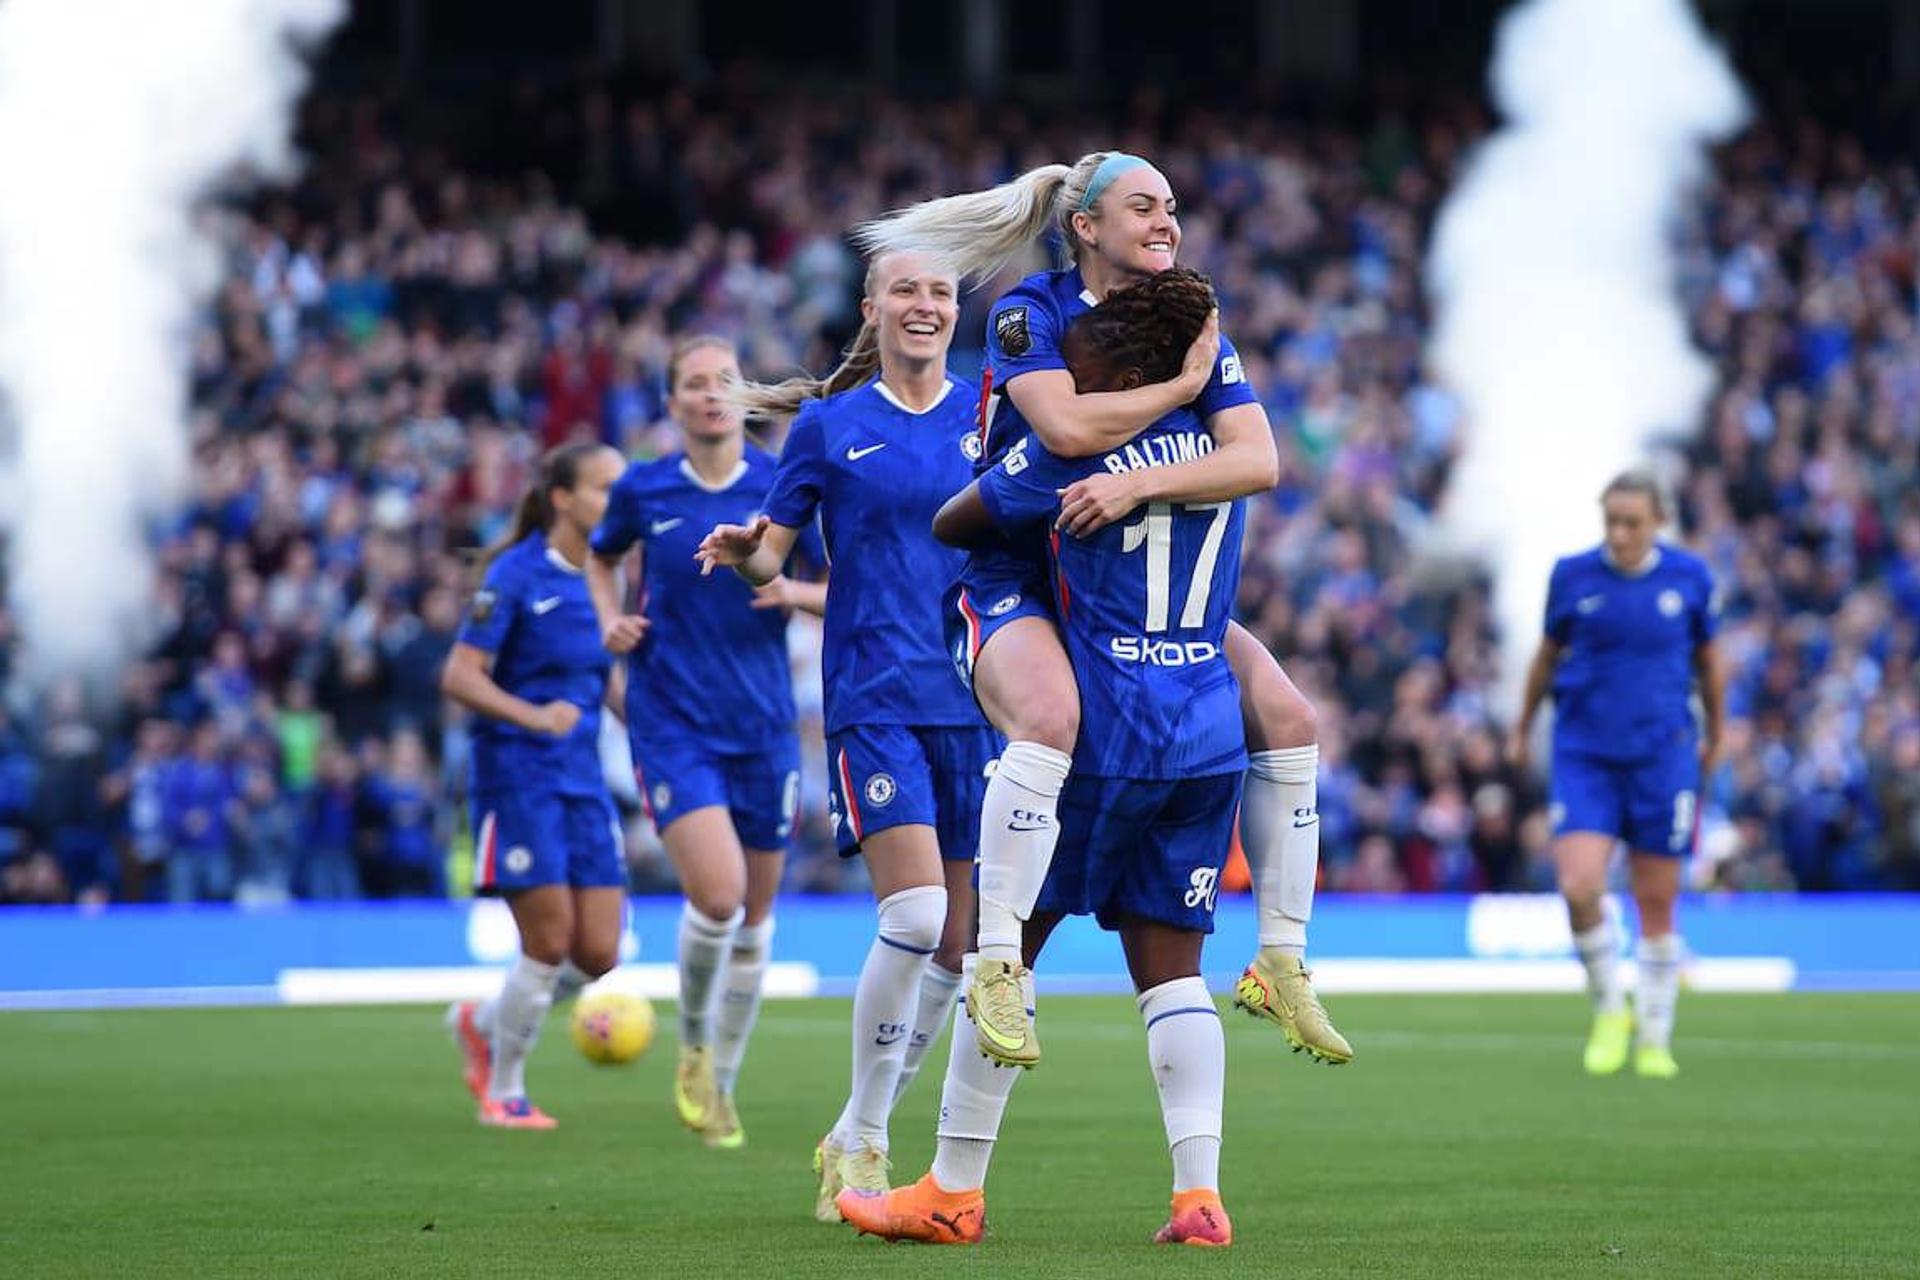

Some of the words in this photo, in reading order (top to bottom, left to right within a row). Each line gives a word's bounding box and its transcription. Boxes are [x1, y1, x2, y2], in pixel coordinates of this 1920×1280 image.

[1103, 431, 1215, 475] BALTIMO
[1122, 497, 1232, 631] 17
[1111, 636, 1221, 666] SKOD
[1013, 809, 1049, 824] CFC
